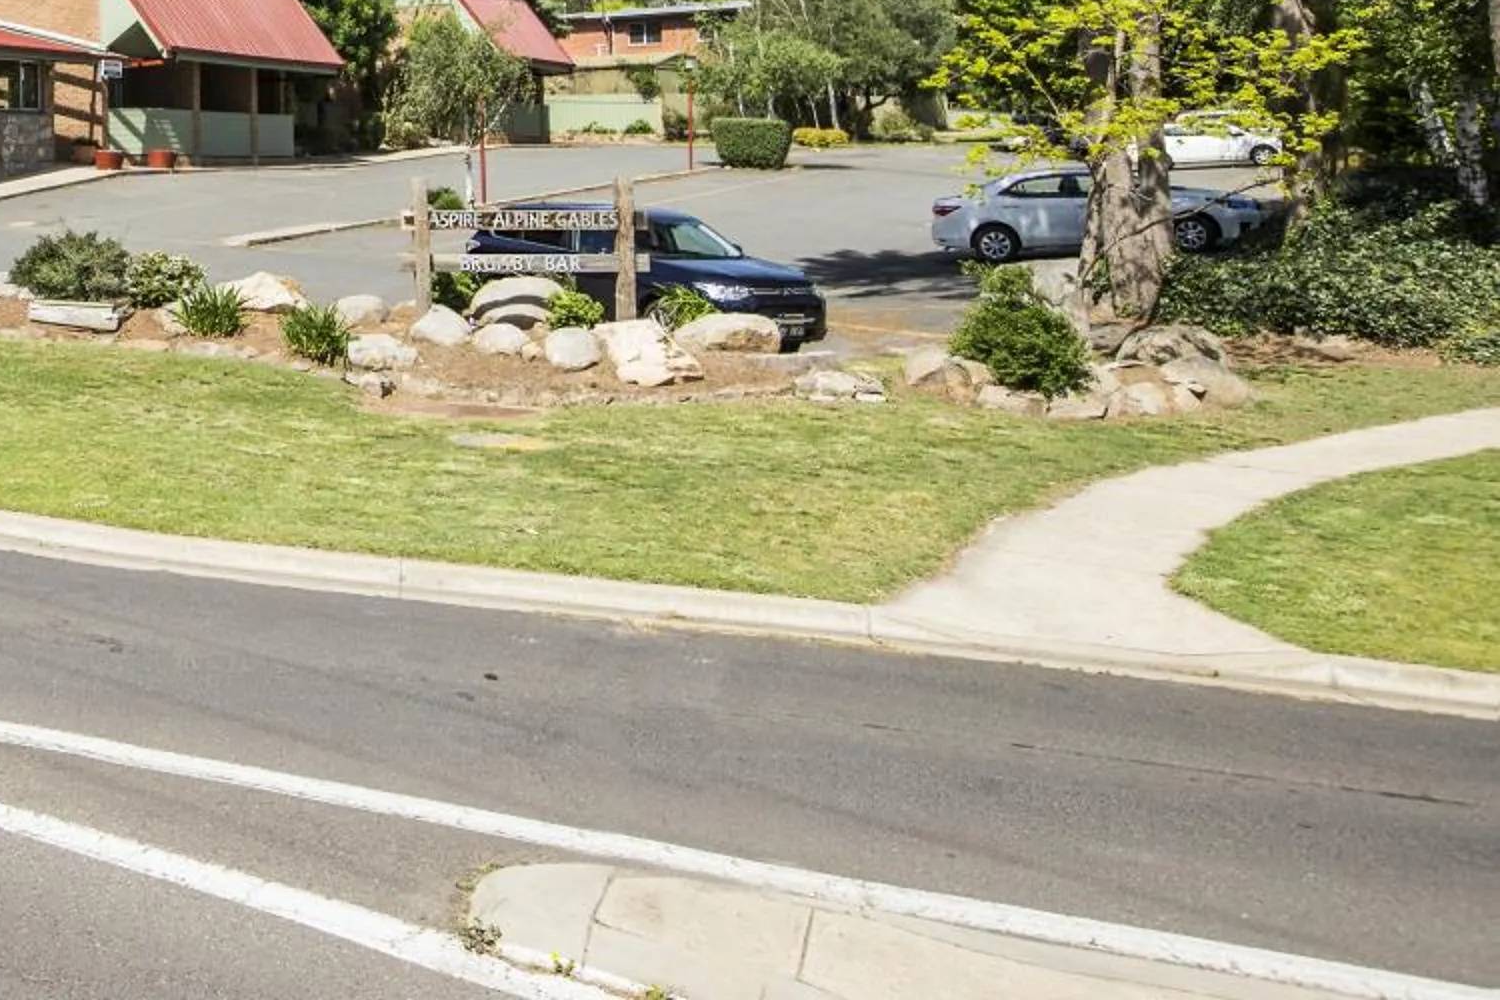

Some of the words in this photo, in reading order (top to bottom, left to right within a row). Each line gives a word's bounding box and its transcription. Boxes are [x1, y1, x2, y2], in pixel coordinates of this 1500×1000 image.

[430, 212, 483, 228] ASPIRE
[493, 211, 553, 228] ALPINE
[556, 211, 618, 228] GABLES
[460, 255, 533, 272] BRUMBY
[544, 255, 581, 272] BAR
